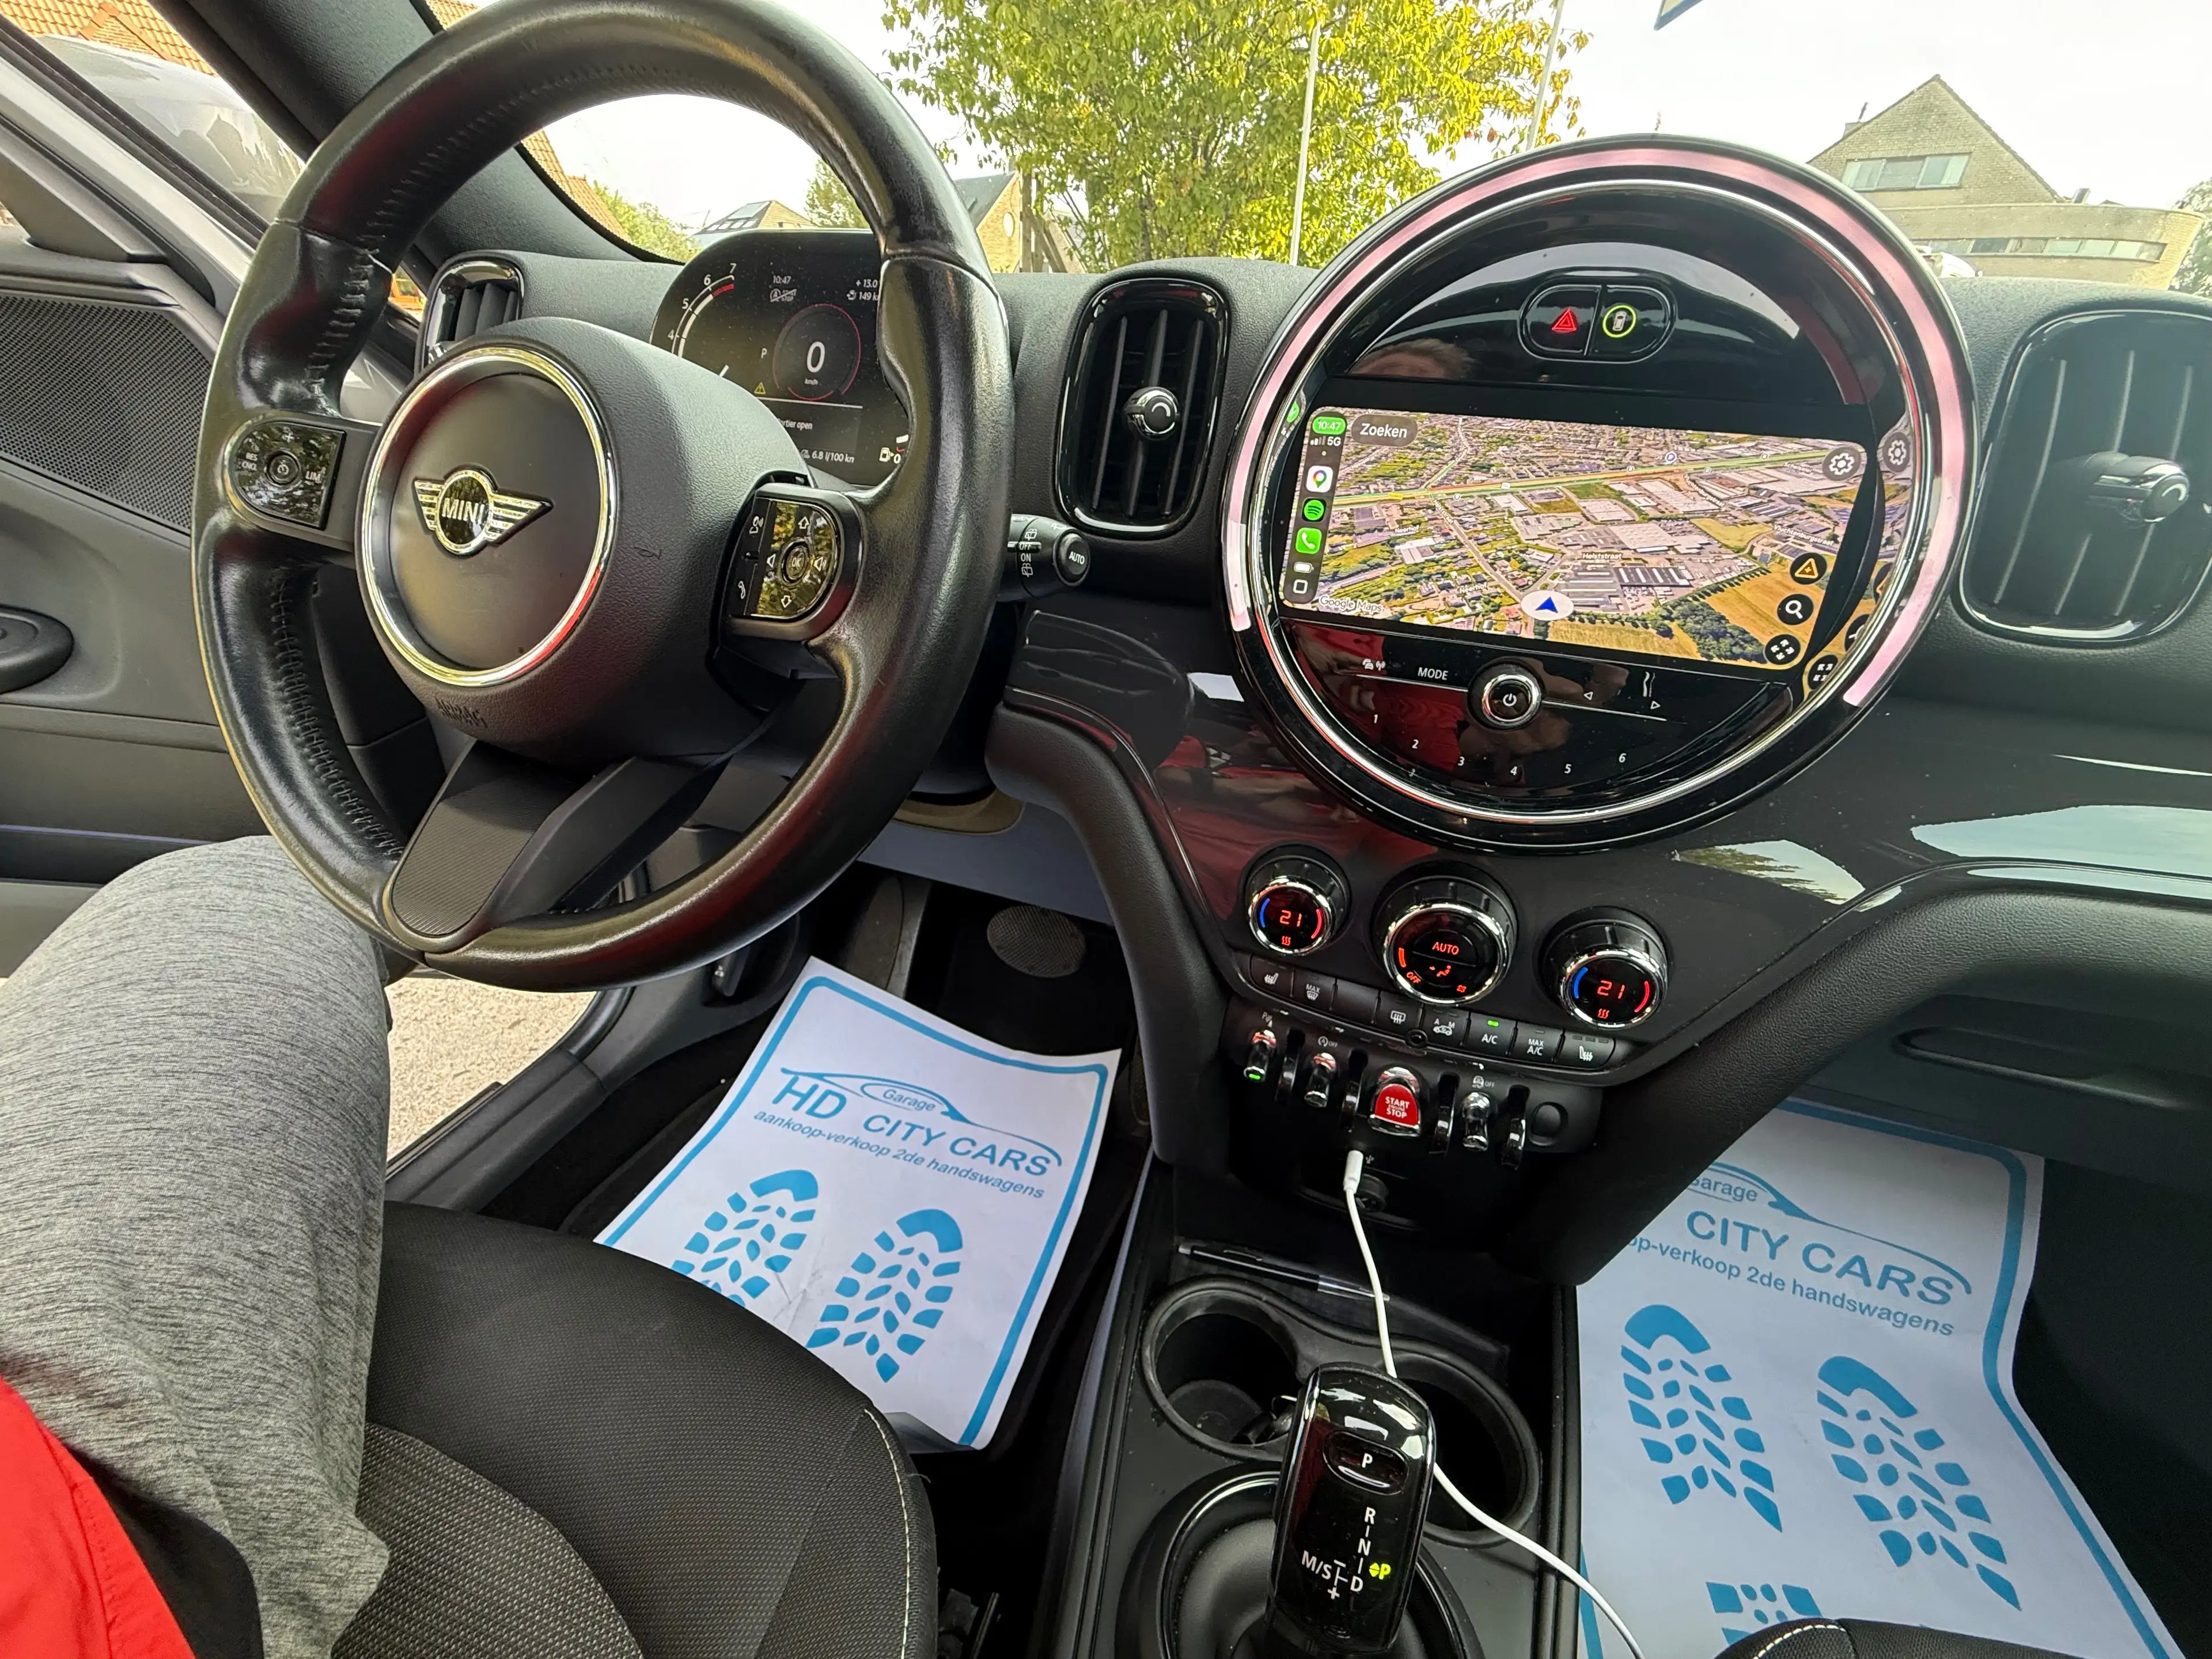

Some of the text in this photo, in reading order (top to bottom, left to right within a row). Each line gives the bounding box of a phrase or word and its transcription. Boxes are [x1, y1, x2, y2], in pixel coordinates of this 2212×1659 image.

[730, 263, 737, 274] 7
[703, 274, 711, 286] 6
[772, 275, 791, 285] 10:47
[863, 279, 878, 289] 13.0
[859, 291, 872, 301] 149
[681, 298, 690, 309] 5
[667, 329, 675, 340] 4
[760, 347, 768, 359] P
[806, 341, 825, 373] 0
[797, 422, 813, 431] open
[1317, 421, 1342, 431] 10:47
[1359, 423, 1408, 438] Zoeken
[1327, 437, 1342, 446] 5G
[812, 450, 824, 460] 6.8
[825, 452, 844, 462] l/100
[893, 453, 902, 464] 0
[306, 471, 321, 482] LIM
[442, 497, 486, 524] MINI
[1395, 525, 1420, 534] Neerhof
[1018, 543, 1032, 551] OFF
[792, 558, 803, 567] OK
[1020, 553, 1032, 562] ON
[1069, 551, 1085, 565] AUTO
[1459, 582, 1487, 594] Neerhof
[1320, 595, 1382, 613] Google Maps
[1418, 666, 1448, 680] MODE
[1373, 714, 1378, 724] 1
[1412, 739, 1419, 749] 2
[1458, 756, 1465, 767] 3
[1619, 752, 1627, 763] 6
[1510, 766, 1518, 777] 4
[1564, 763, 1572, 775] 5
[1279, 910, 1302, 927] 21
[1431, 941, 1459, 955] AUTO
[1406, 971, 1421, 984] OFF
[1306, 983, 1320, 994] MAX
[1597, 980, 1625, 999] 21
[1481, 1033, 1498, 1045] A/C
[1528, 1038, 1544, 1047] MAX
[1527, 1046, 1543, 1056] A/C
[771, 1075, 847, 1119] HD
[882, 1088, 936, 1112] Garage
[1385, 1096, 1410, 1109] START
[1386, 1107, 1407, 1119] STOP
[863, 1114, 1051, 1177] CITY CARS
[753, 1110, 1044, 1199] aankoop-verkoop 2de handswagens
[1686, 1210, 1954, 1305] CITY CARS
[1746, 1266, 1786, 1291] 2de
[1791, 1278, 1955, 1336] handswagens
[1361, 1453, 1373, 1468] P
[1364, 1507, 1376, 1525] R
[1357, 1538, 1372, 1556] N
[1301, 1550, 1332, 1581] M/S
[1378, 1563, 1391, 1580] P
[1350, 1575, 1363, 1592] D
